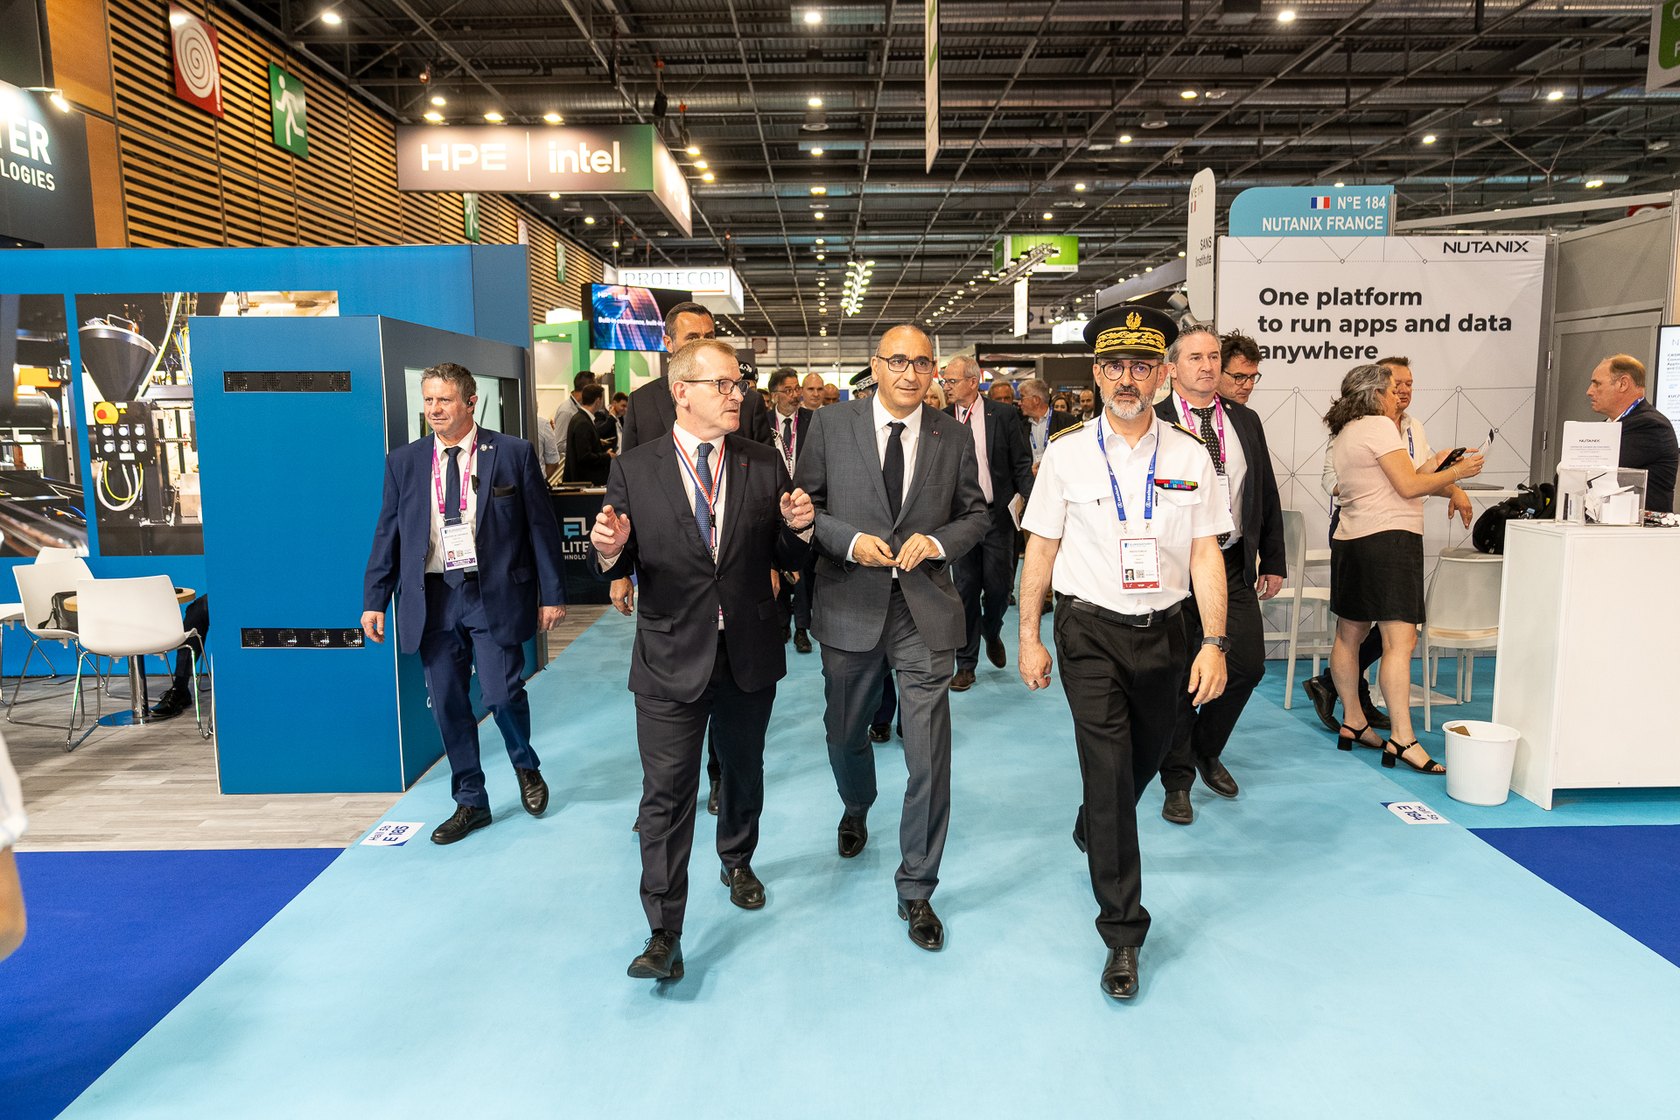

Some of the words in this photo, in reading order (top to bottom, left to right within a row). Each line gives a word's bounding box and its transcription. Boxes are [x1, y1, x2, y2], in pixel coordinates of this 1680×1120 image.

[0, 114, 52, 166] ER
[420, 143, 507, 172] HPE
[1337, 196, 1361, 210] N°E
[1365, 196, 1386, 209] 184
[1262, 216, 1323, 232] NUTANIX
[1326, 215, 1384, 230] FRANCE
[1200, 236, 1212, 251] SANS
[1443, 241, 1529, 253] NUTANIX
[624, 271, 725, 286] PROTECOP
[1259, 287, 1309, 306] One
[1316, 286, 1422, 310] platform
[1257, 316, 1283, 333] to
[1290, 318, 1331, 333] run
[1339, 318, 1398, 337] apps
[1404, 313, 1450, 333] and
[1458, 313, 1512, 332] data
[1258, 341, 1378, 364] anywhere
